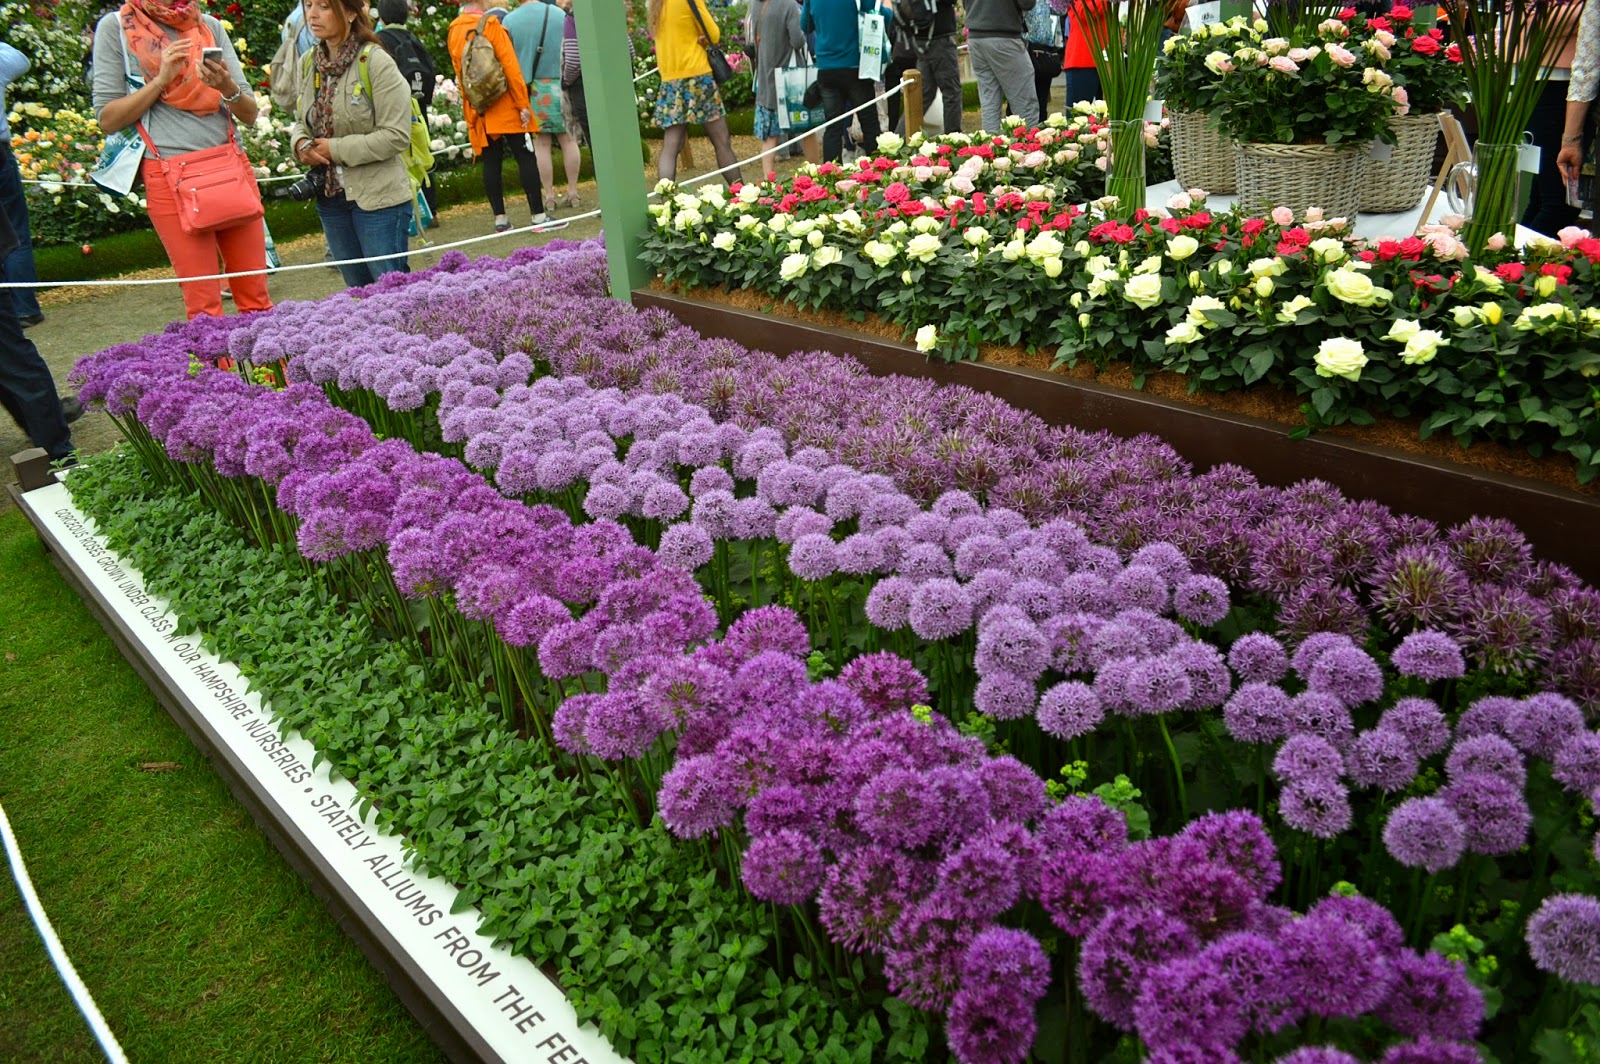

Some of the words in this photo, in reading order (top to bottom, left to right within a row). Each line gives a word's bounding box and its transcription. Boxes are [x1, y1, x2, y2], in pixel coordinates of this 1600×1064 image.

[54, 508, 89, 538] GORGEOUS
[79, 535, 106, 558] ROSES
[96, 556, 127, 583] GROWN
[118, 580, 150, 608] UNDER
[140, 605, 174, 633] GLASS
[162, 632, 181, 644] IN
[173, 642, 202, 665] OUR
[191, 662, 254, 721] HAMPSHIRE
[241, 718, 313, 784] NURSERIES
[310, 793, 378, 852] STATELY
[363, 853, 444, 927] ALLIUMS
[433, 925, 501, 988] FROM
[492, 984, 546, 1035] THE
